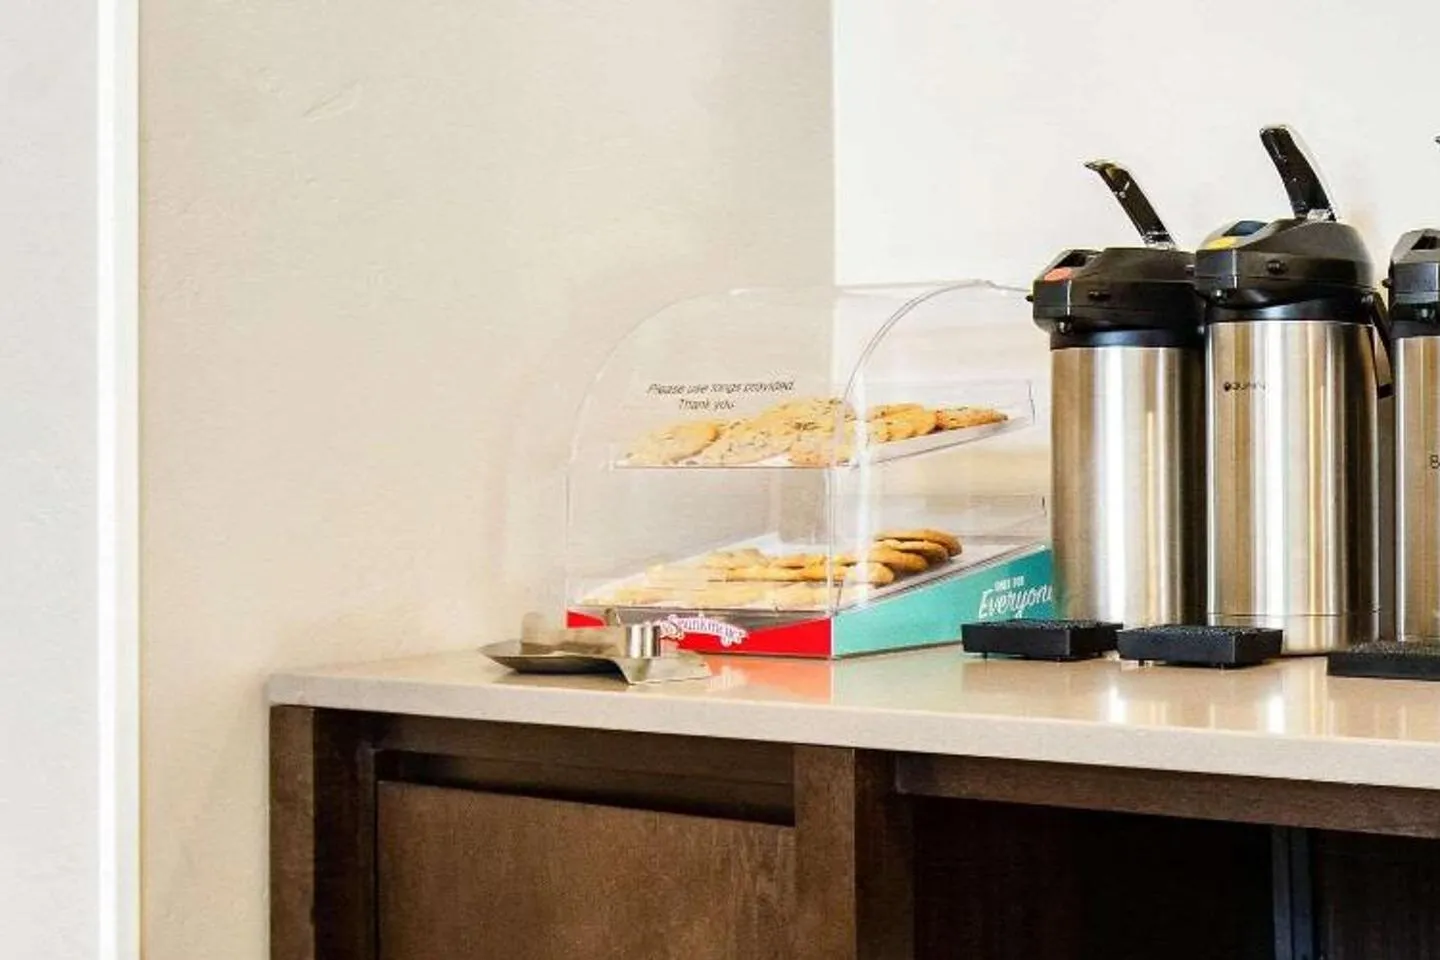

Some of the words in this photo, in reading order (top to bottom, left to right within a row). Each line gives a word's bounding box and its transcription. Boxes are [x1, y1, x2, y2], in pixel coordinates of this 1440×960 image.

[647, 383, 685, 394] Please
[686, 384, 709, 394] use
[679, 398, 710, 410] Thank
[712, 400, 735, 411] you
